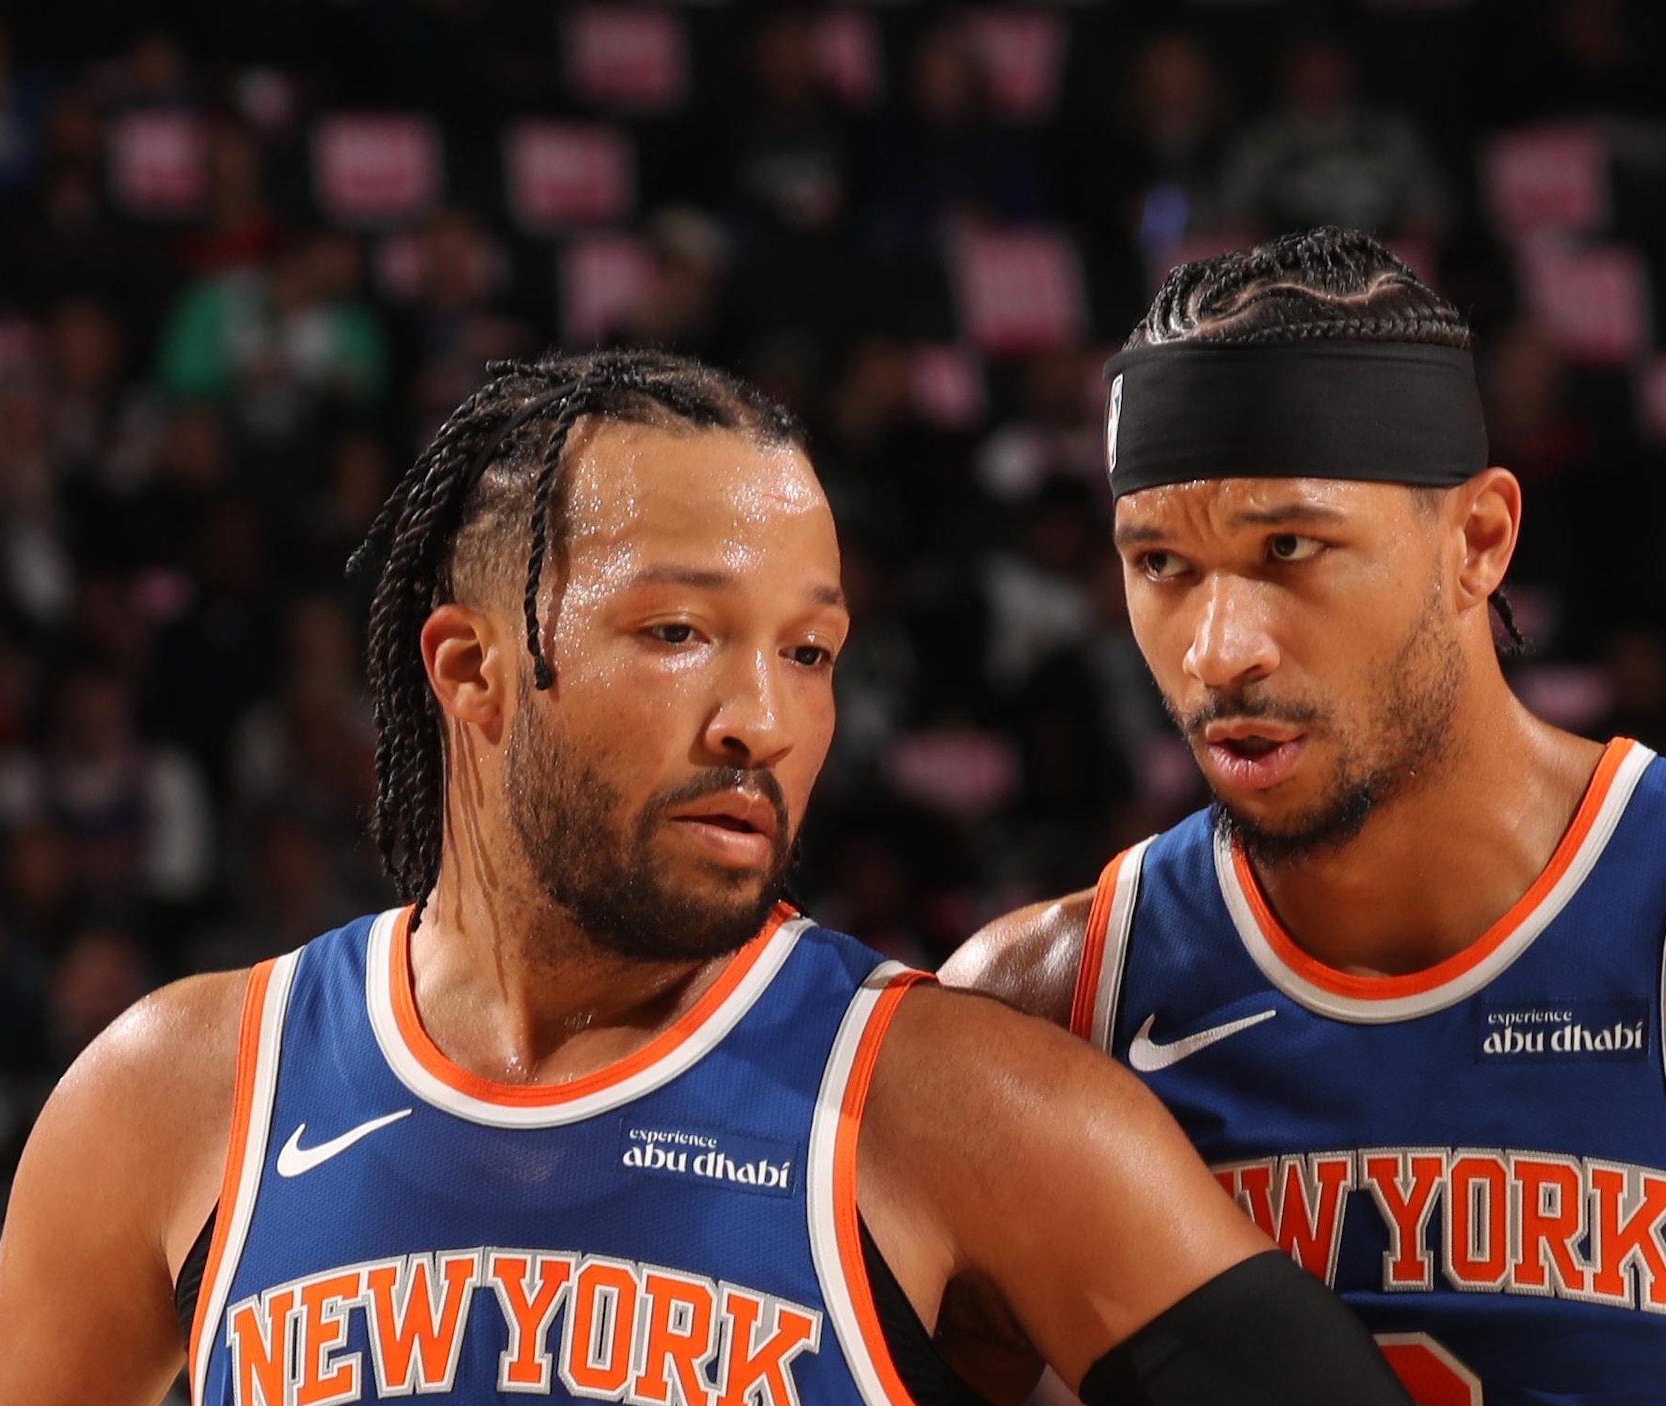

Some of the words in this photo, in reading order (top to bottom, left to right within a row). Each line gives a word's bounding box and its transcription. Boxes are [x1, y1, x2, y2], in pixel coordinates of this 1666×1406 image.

[1487, 1010, 1573, 1026] experience
[1483, 1026, 1544, 1054] abu
[1550, 1021, 1643, 1052] dhabi
[629, 1128, 717, 1149] experience
[622, 1143, 688, 1173] abu
[692, 1151, 791, 1188] dhabi
